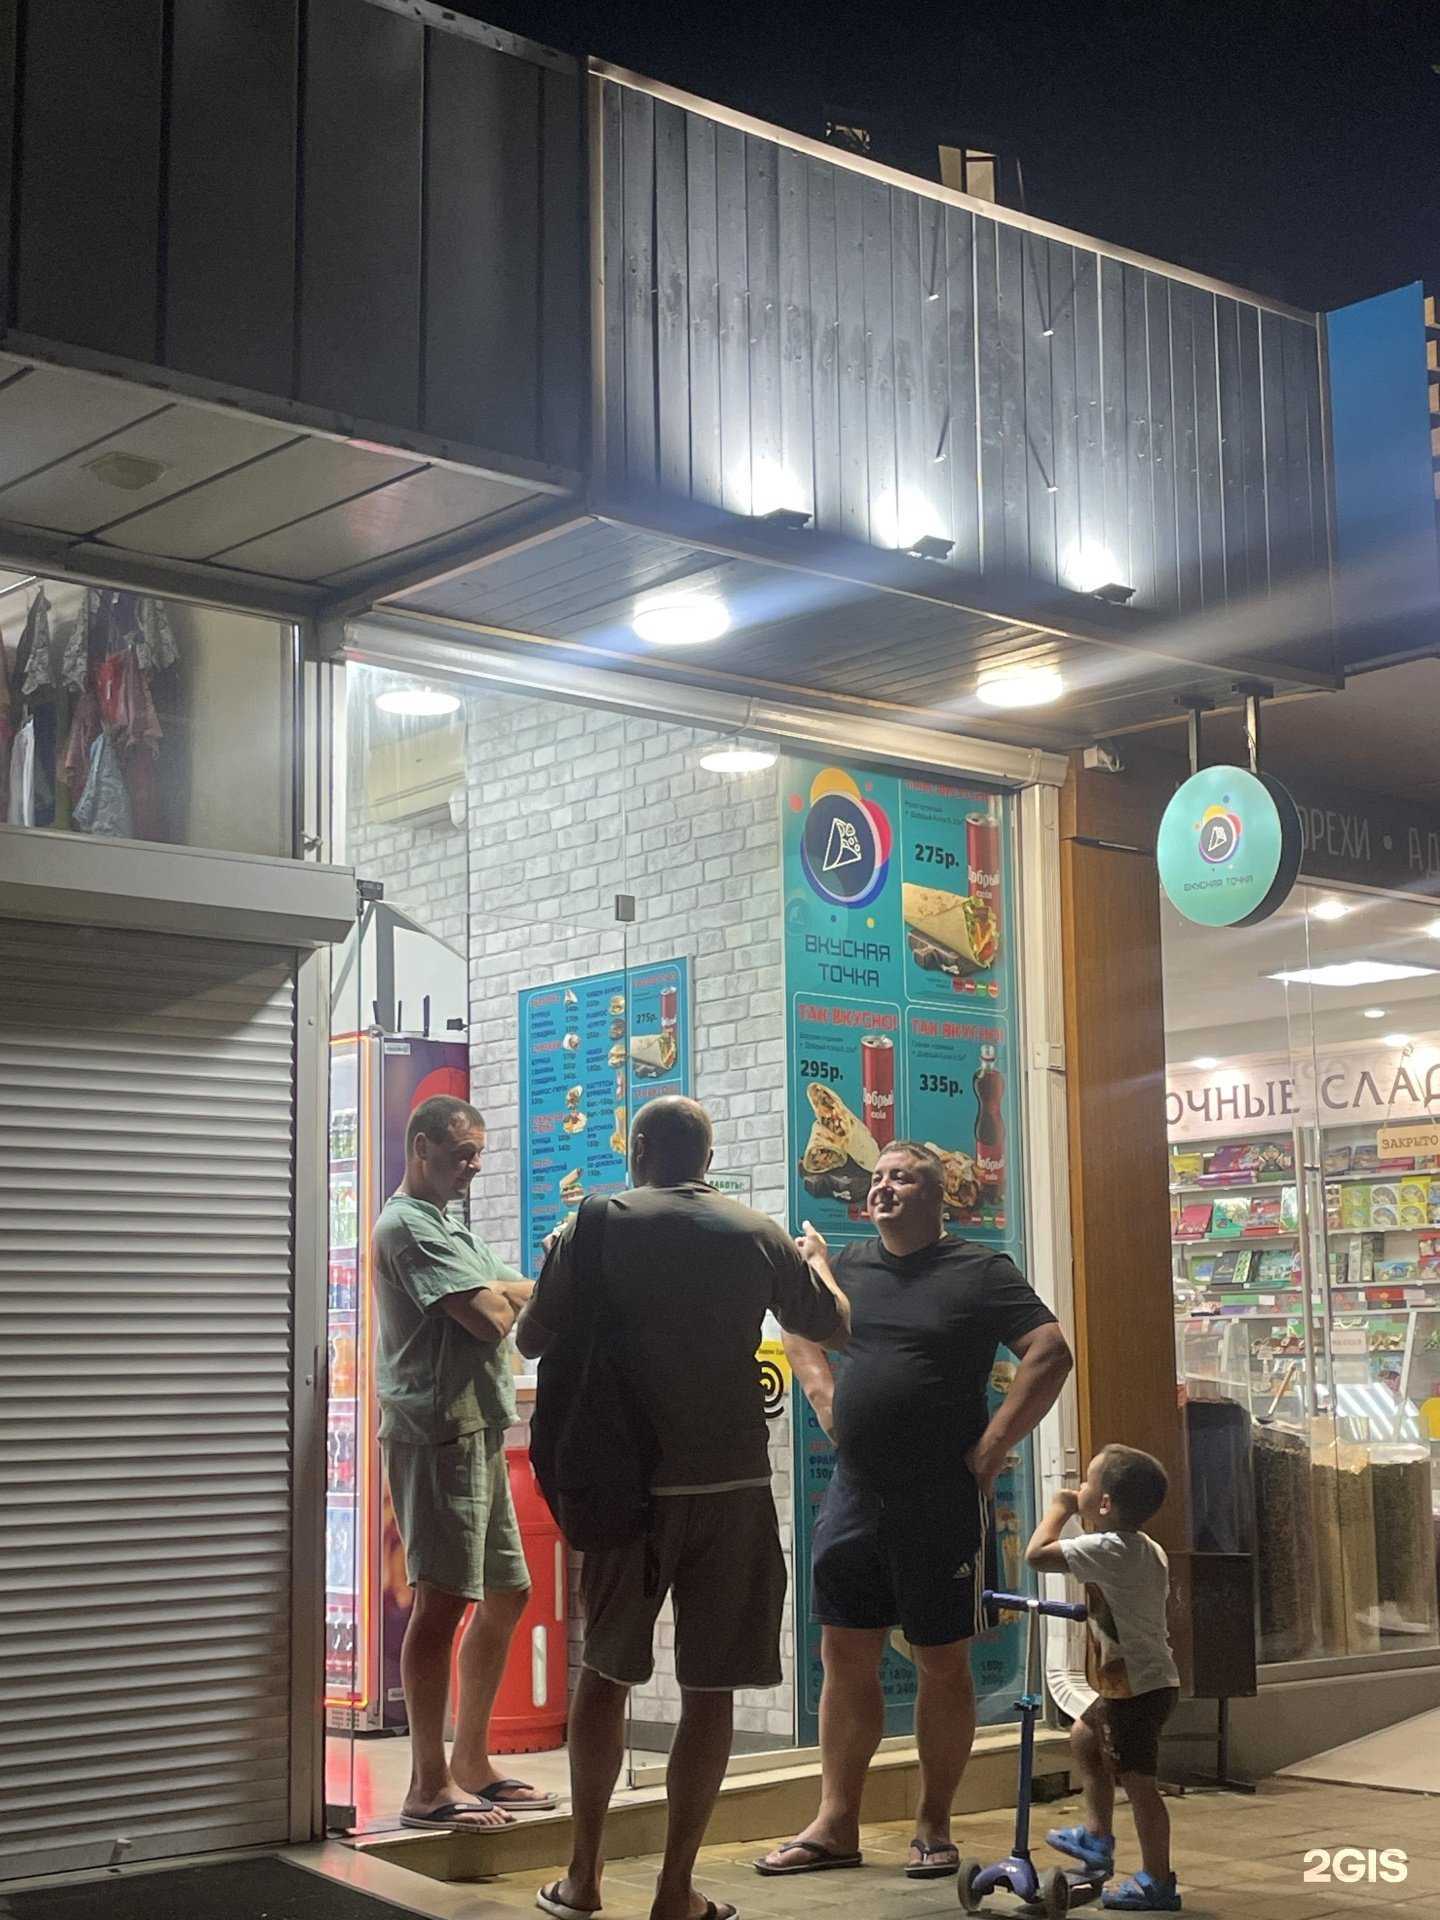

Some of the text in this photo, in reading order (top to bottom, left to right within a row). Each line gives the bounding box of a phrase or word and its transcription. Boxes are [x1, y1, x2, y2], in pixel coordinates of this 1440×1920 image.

[914, 842, 960, 869] 275р.
[805, 934, 891, 963] ВКУСНАЯ
[818, 963, 880, 987] ТОЧКА
[800, 1059, 844, 1082] 295р.
[919, 1073, 963, 1098] 335р.
